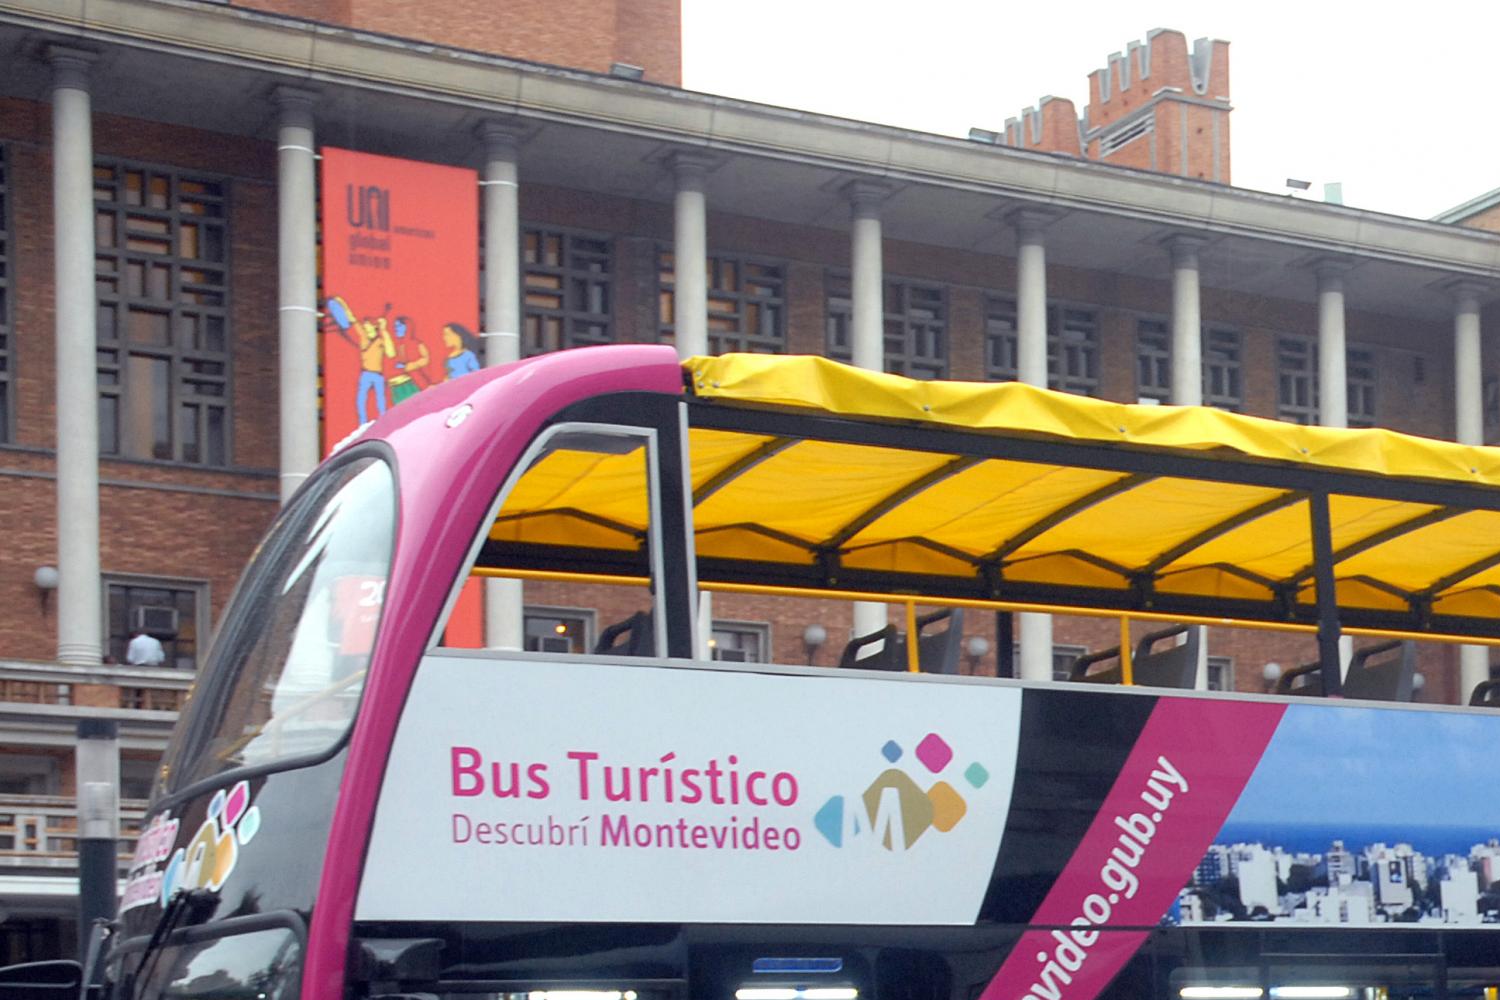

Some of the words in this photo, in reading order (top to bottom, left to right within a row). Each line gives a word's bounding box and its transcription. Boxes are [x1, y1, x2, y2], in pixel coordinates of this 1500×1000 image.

[451, 746, 550, 800] Bus
[567, 751, 799, 807] Turístico
[452, 813, 590, 846] Descubrí
[600, 814, 801, 850] Montevideo
